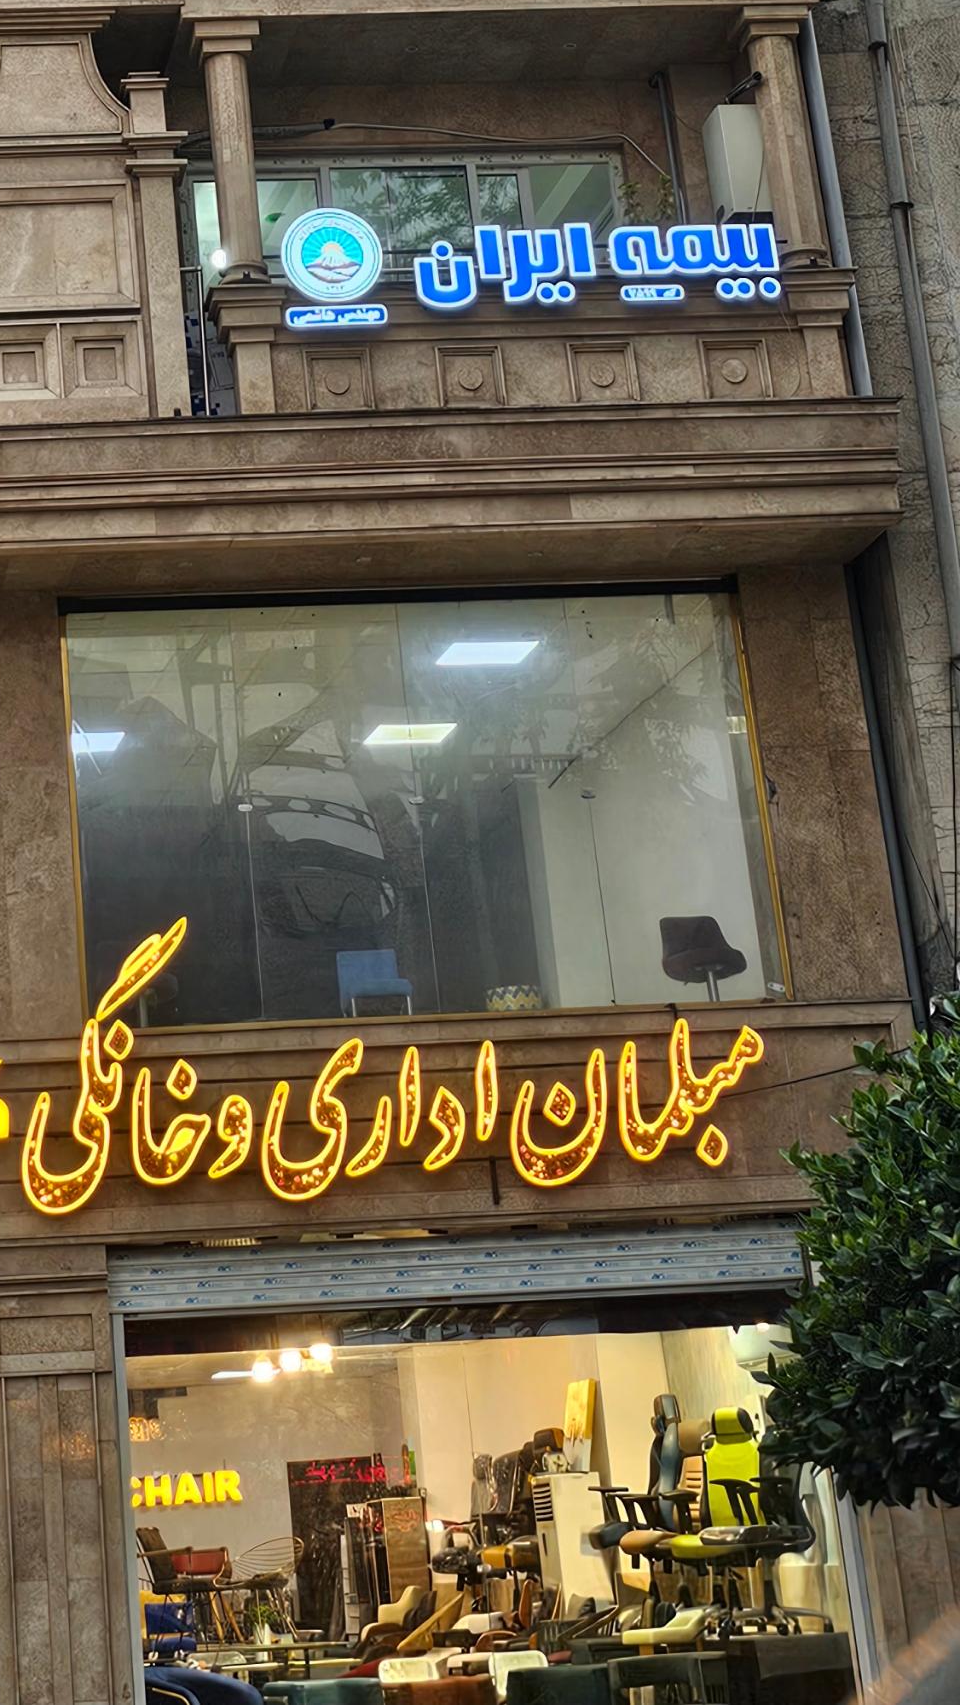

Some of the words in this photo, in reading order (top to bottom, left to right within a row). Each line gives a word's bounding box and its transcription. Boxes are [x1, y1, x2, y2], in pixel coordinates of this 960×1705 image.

[413, 221, 596, 311] ایران
[607, 222, 782, 298] بیمه
[21, 915, 210, 1216] خانگی
[261, 1037, 498, 1202] اداری
[510, 1017, 765, 1187] مبلمان
